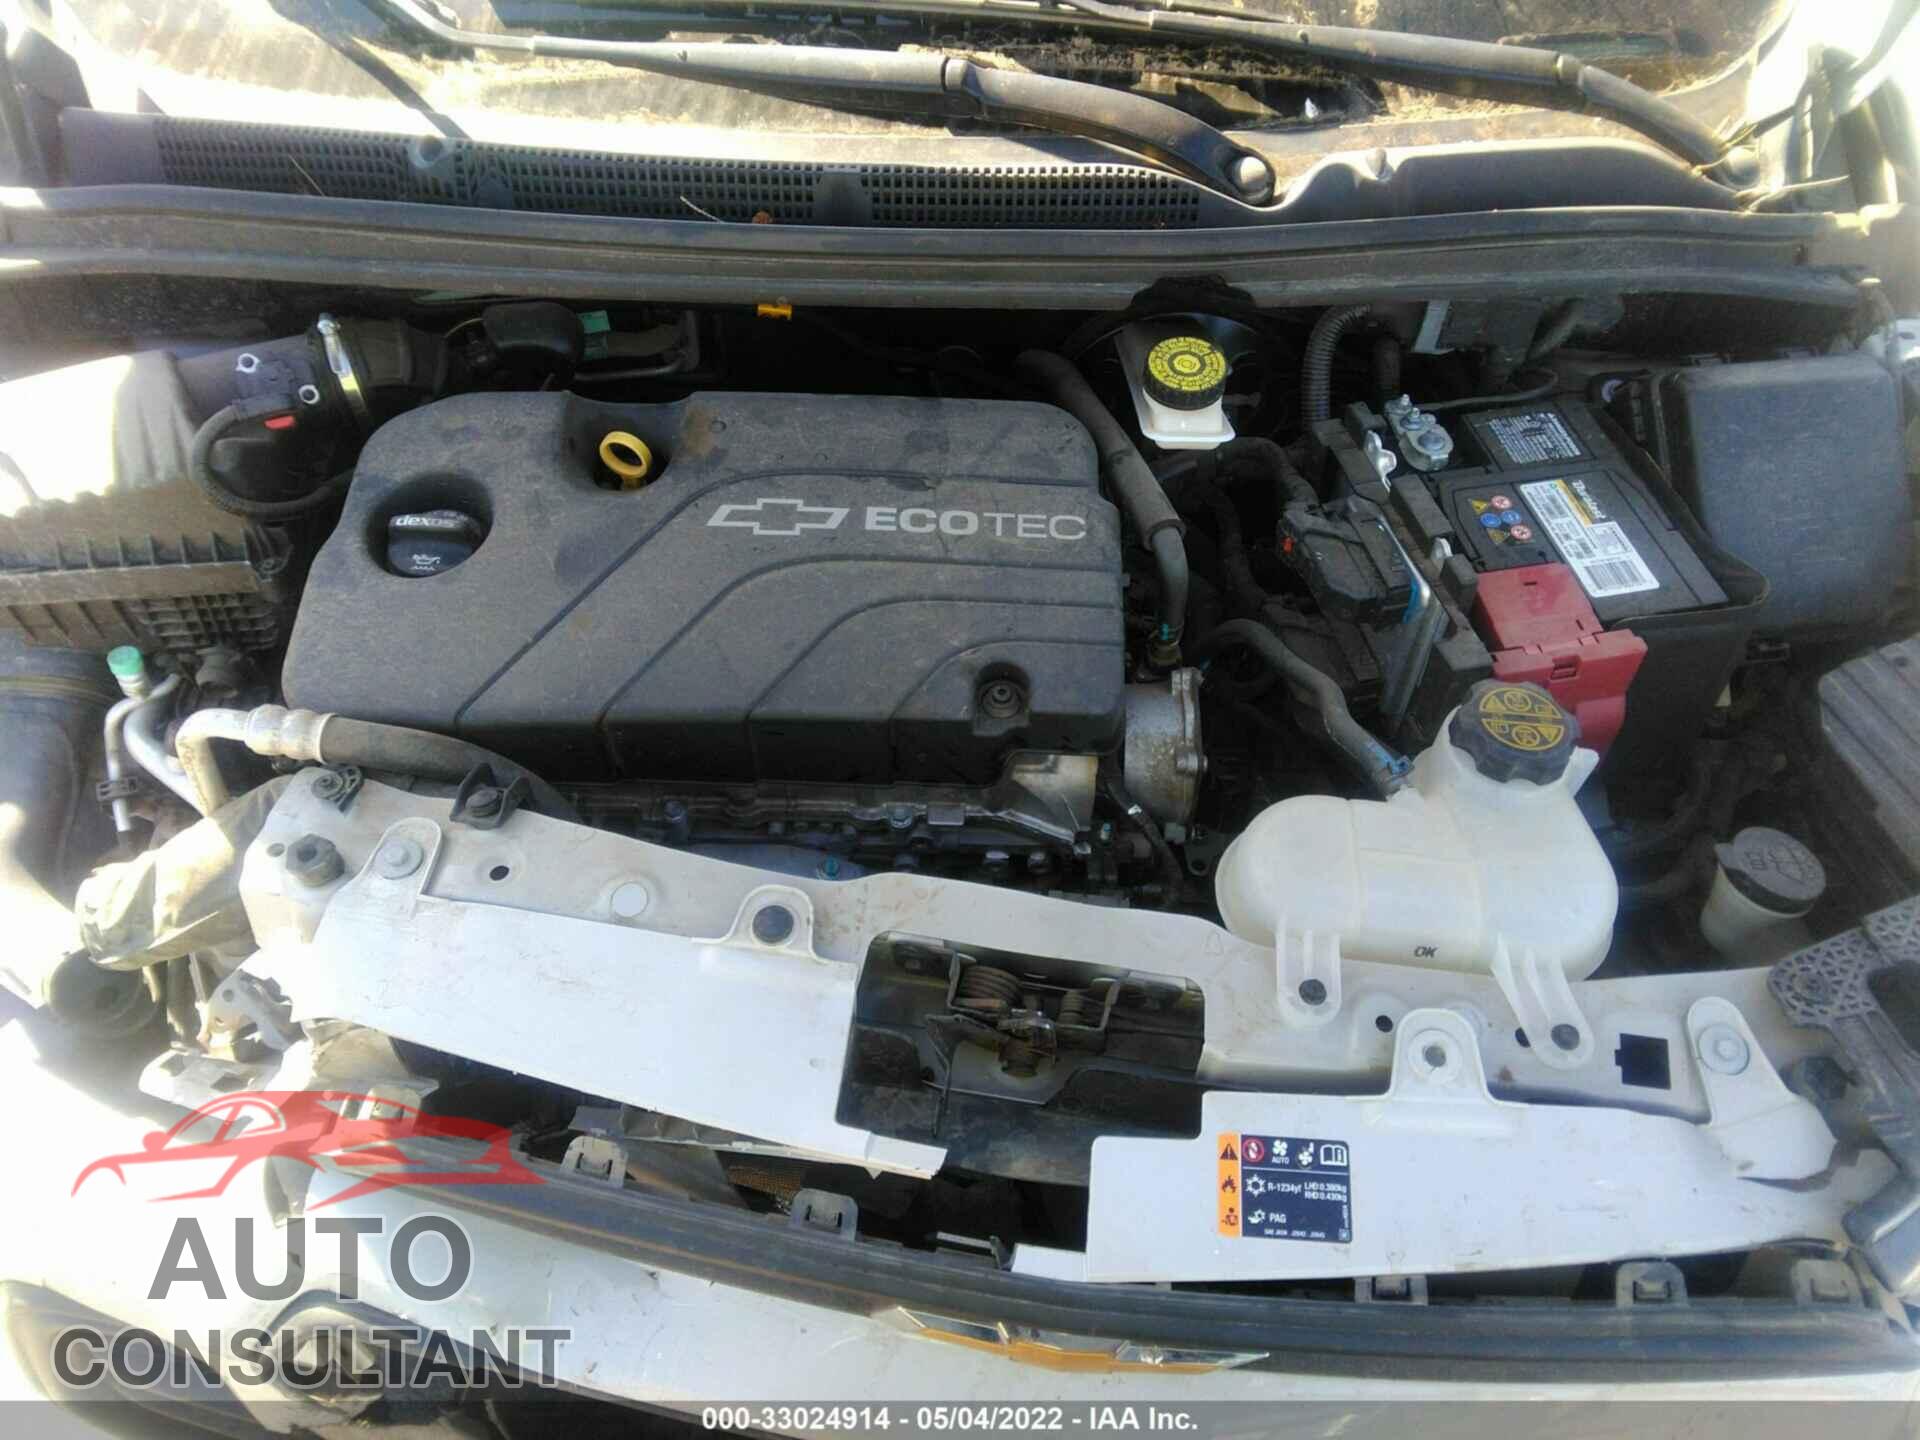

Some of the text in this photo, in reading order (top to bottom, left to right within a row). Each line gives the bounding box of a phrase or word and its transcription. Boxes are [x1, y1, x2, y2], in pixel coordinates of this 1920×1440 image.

[864, 506, 1087, 541] ECOTEC
[1413, 945, 1438, 960] OK
[1267, 1182, 1302, 1193] R-1234yf
[1269, 1213, 1287, 1224] PAG
